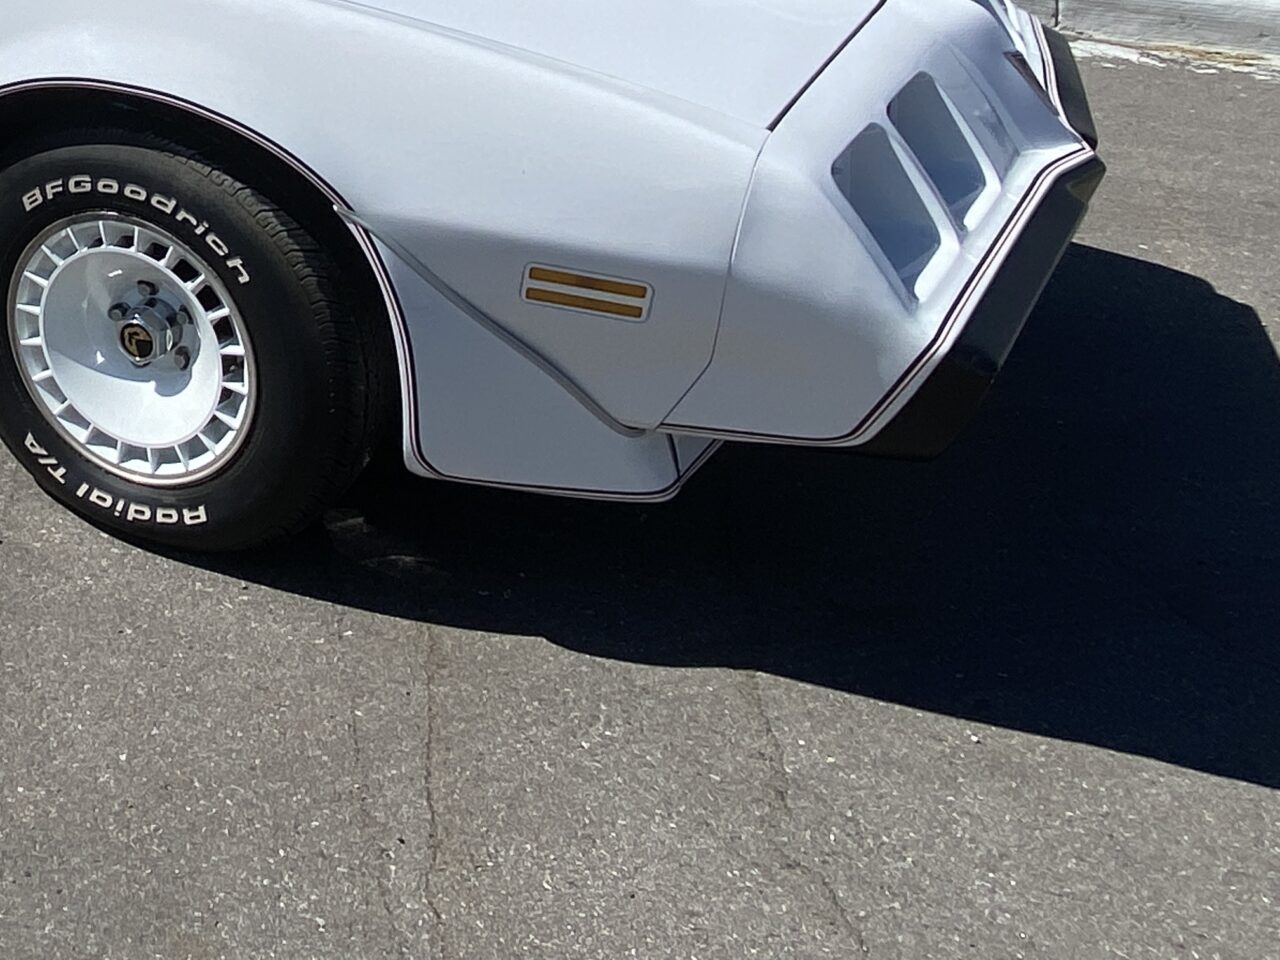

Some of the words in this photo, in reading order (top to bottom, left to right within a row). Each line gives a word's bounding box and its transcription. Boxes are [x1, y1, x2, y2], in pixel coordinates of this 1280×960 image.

[22, 174, 252, 286] BFGoodrich
[24, 431, 68, 485] T/A
[75, 482, 208, 527] Radial
